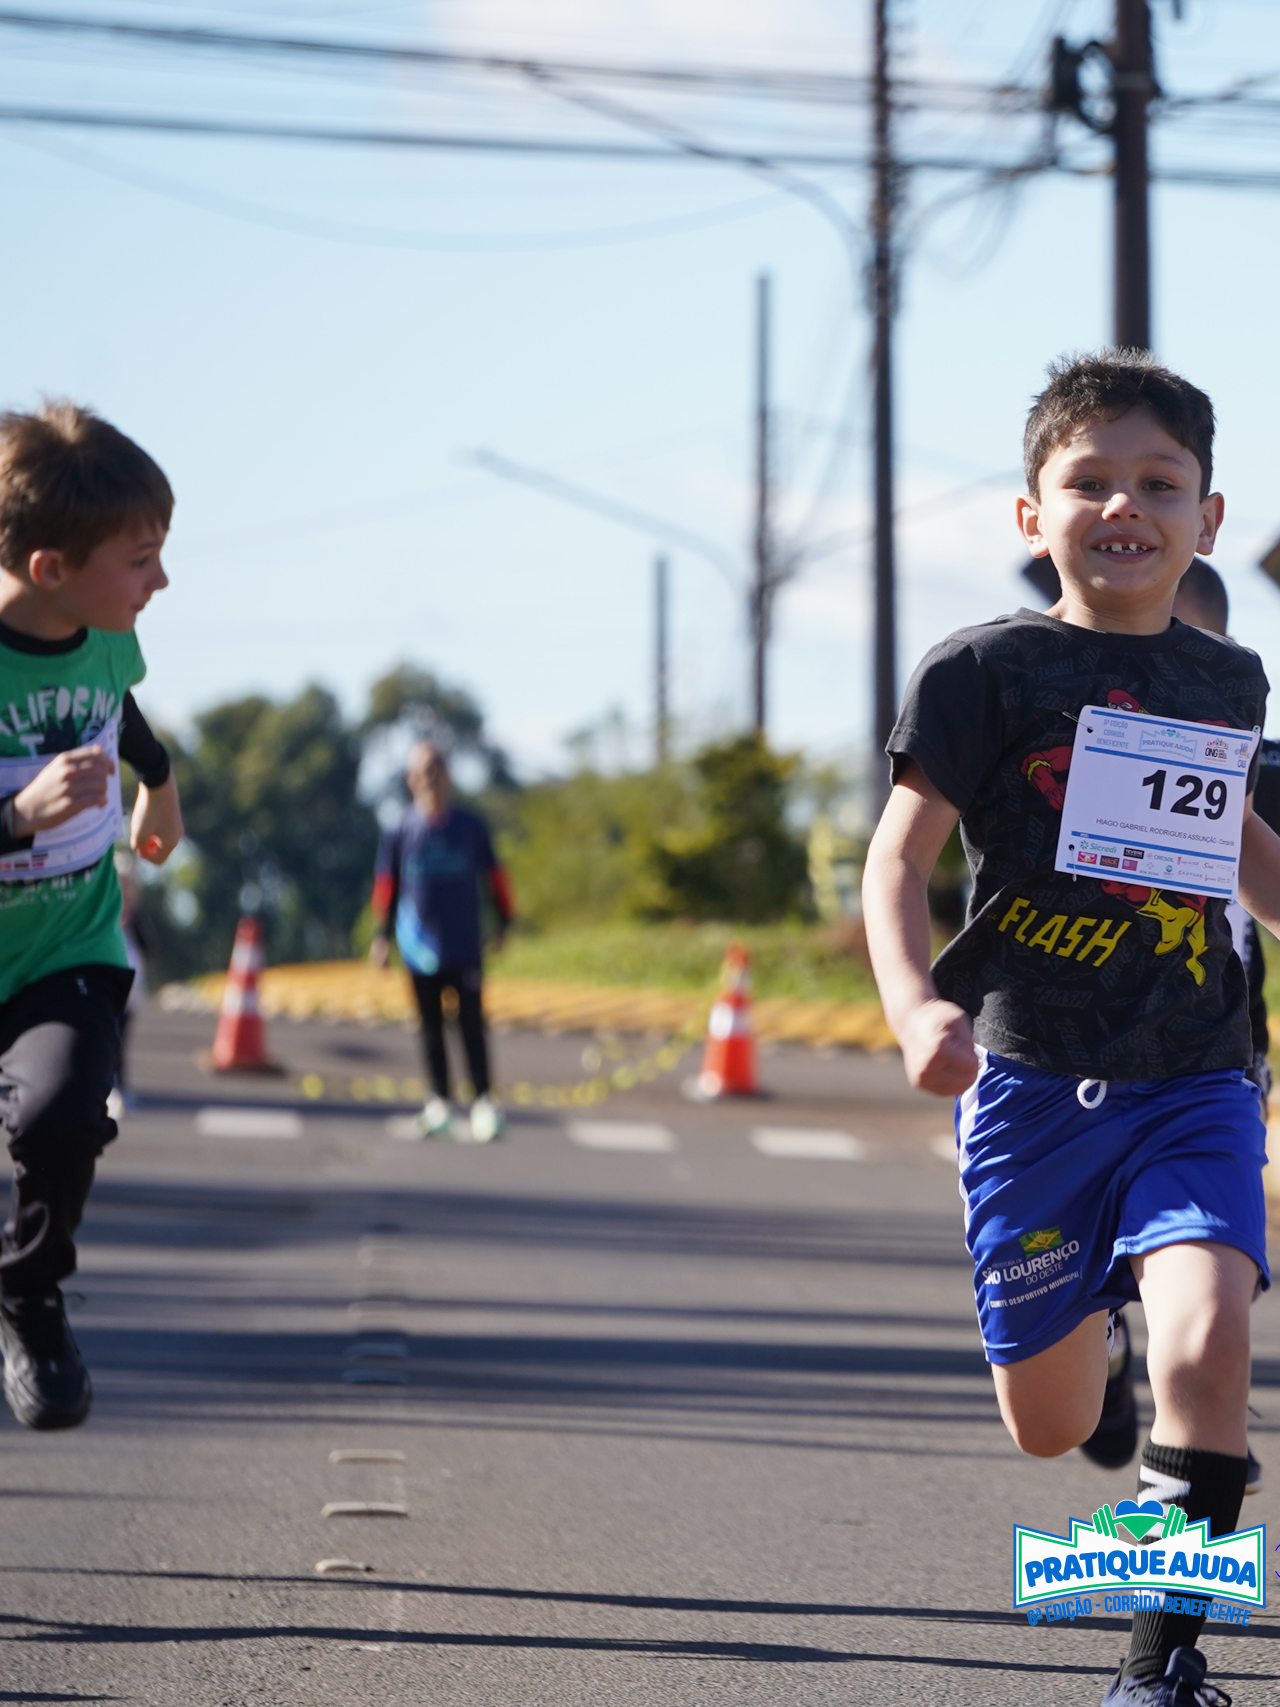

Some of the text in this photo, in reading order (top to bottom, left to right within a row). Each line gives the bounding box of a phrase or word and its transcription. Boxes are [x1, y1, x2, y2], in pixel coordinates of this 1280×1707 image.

[1096, 737, 1129, 749] BENEFICENTE
[1142, 739, 1193, 754] PRATIQUE AJUDA
[1205, 747, 1218, 758] ONG
[1142, 769, 1228, 821] 129
[1096, 818, 1118, 828] HIAGO
[1119, 821, 1148, 833] GABRIEL
[1149, 826, 1187, 840] RODRIGUES
[1187, 833, 1217, 844] ASSUNÇÃO
[1090, 842, 1117, 854] Sicredi
[1153, 854, 1174, 862] CRESOL
[998, 897, 1133, 967] FLASH
[982, 1240, 1080, 1285] SÃO LOURENÇO
[1025, 1261, 1064, 1286] DO OESTE
[1008, 1284, 1048, 1306] DESPORTIVO
[1049, 1271, 1080, 1291] MUNICIPAL
